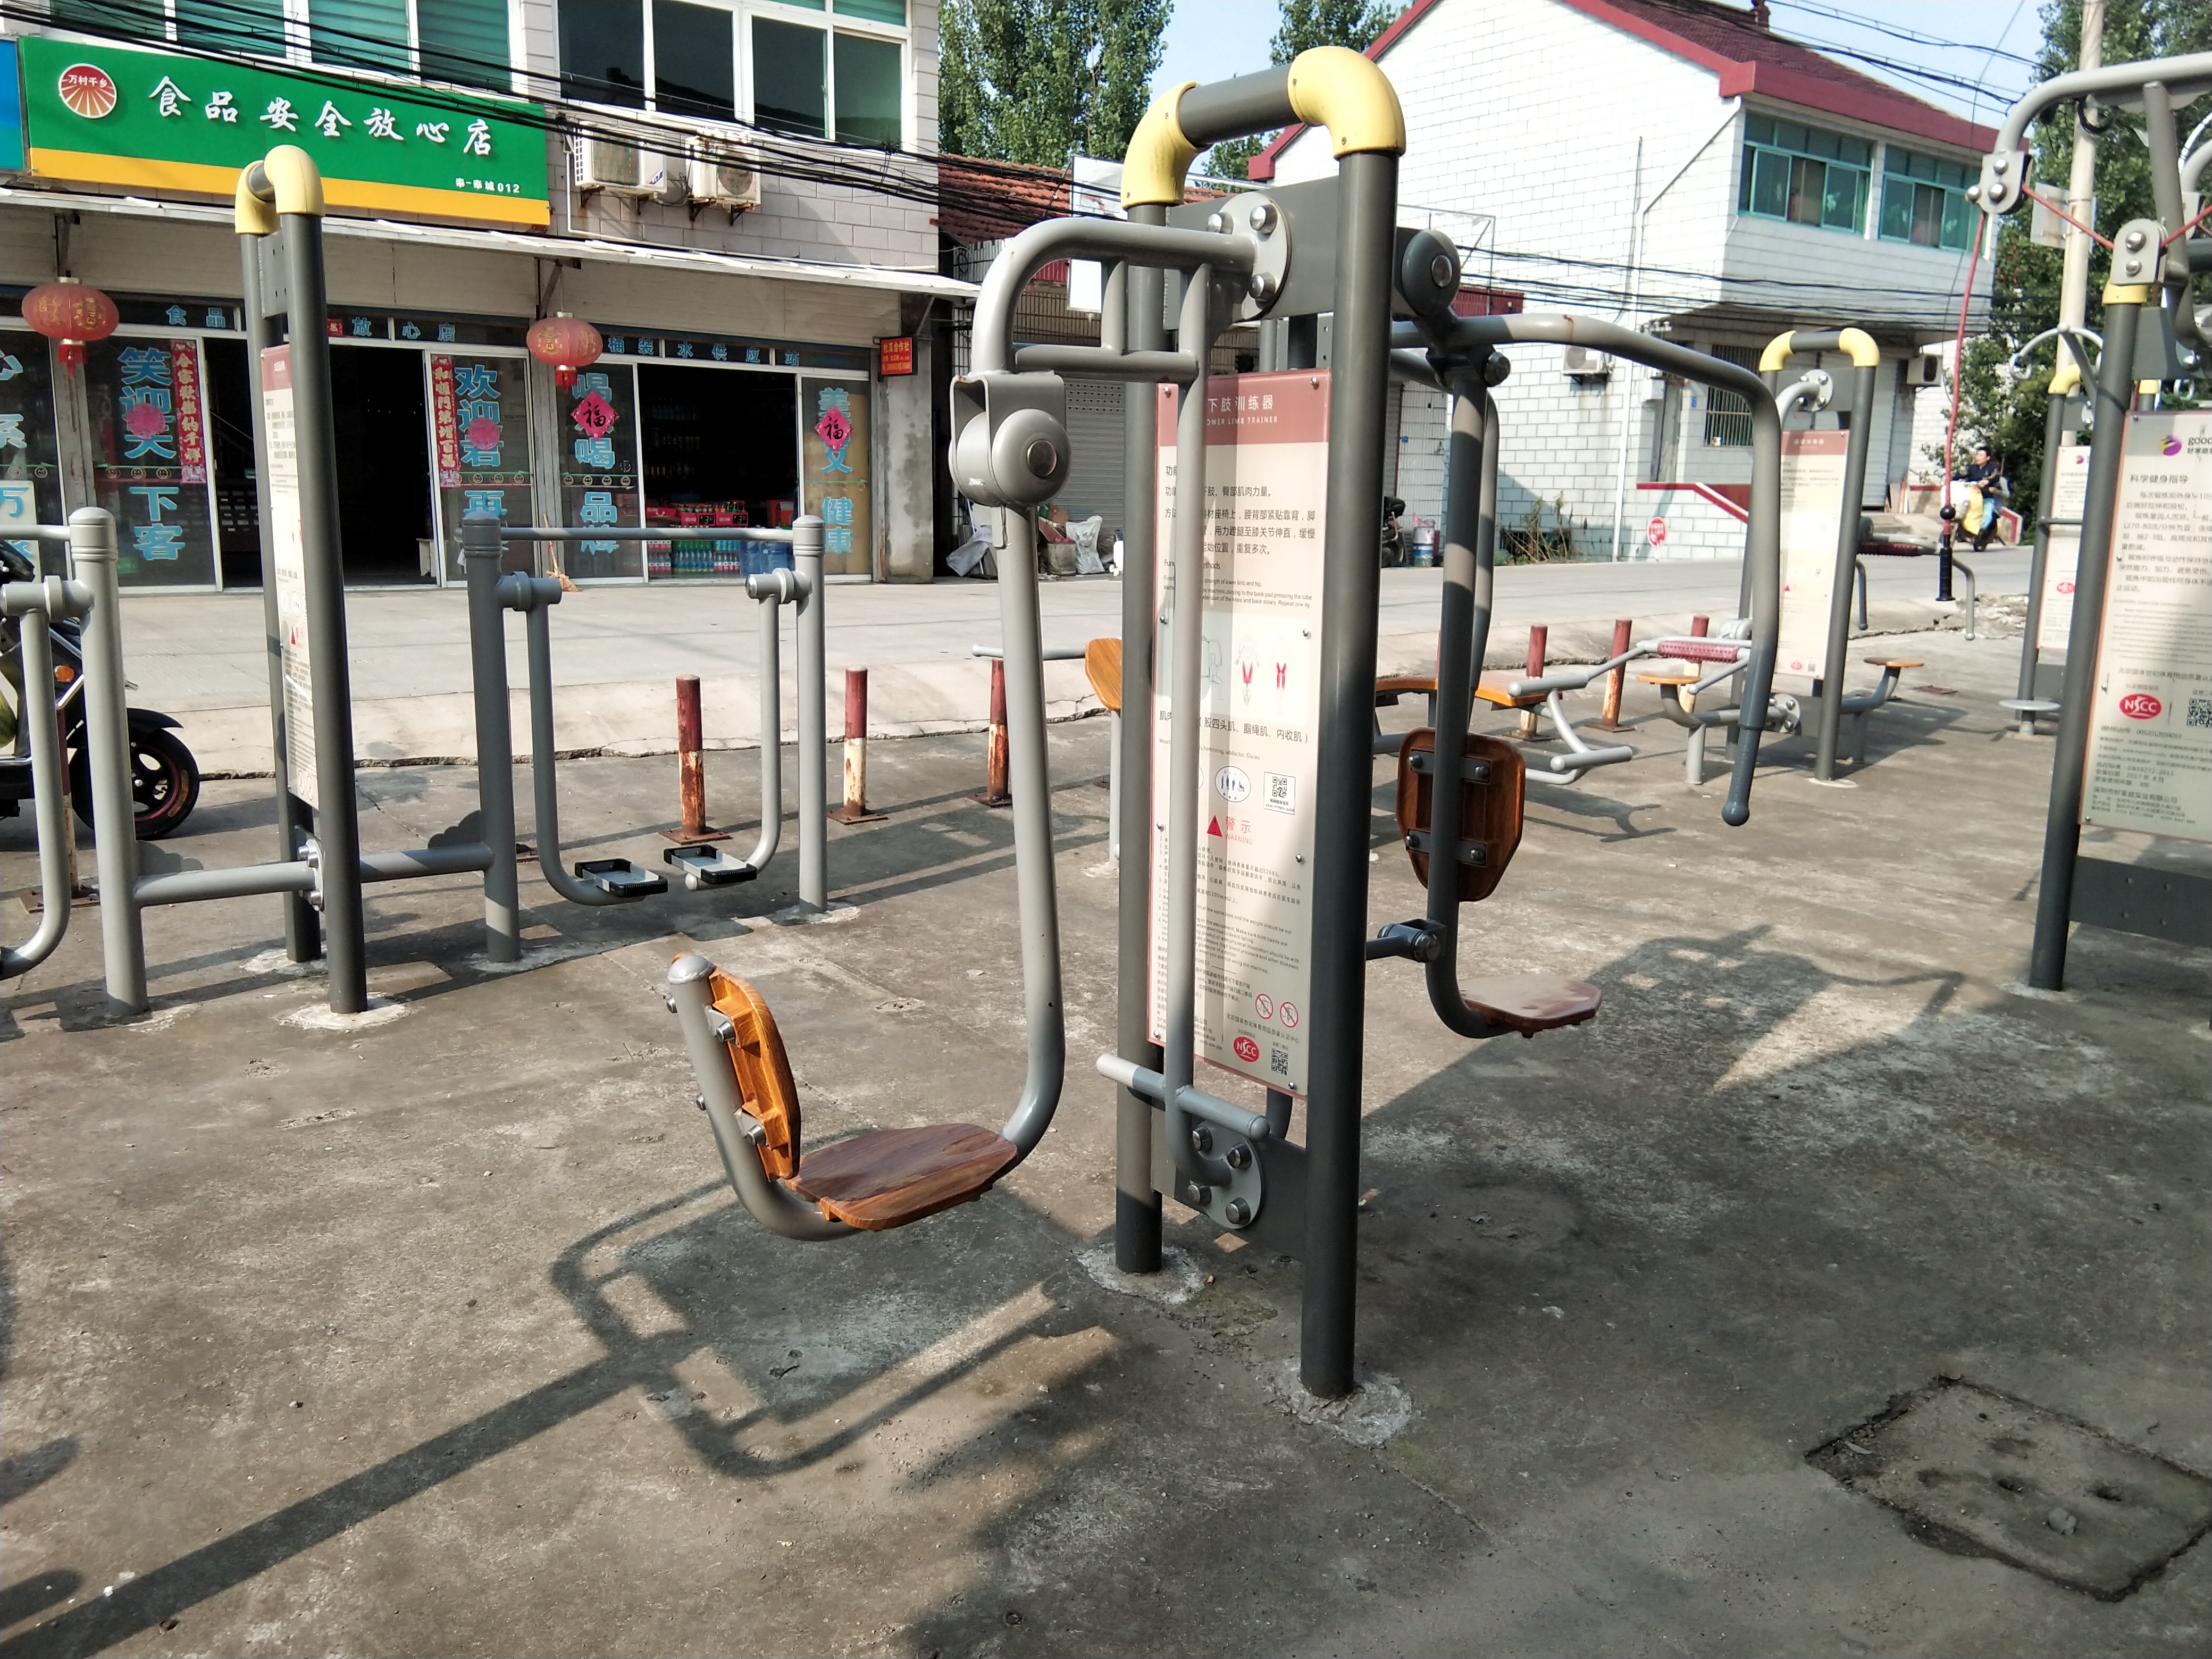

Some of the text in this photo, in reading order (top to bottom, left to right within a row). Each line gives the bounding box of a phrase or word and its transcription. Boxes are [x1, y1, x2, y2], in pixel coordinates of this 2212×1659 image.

[68, 74, 107, 88] 万村千乡
[149, 76, 491, 156] 食品安全放心店
[165, 304, 226, 328] 食品
[352, 317, 456, 342] 放心店
[608, 335, 800, 367] 桶装水供应站
[1208, 395, 1273, 413] 下肢训练器
[583, 401, 606, 428] 福
[1206, 417, 1225, 426] OWER
[824, 415, 844, 440] 福
[118, 346, 186, 561] 笑迎天下客
[2130, 474, 2188, 483] 科学健身指导
[1203, 562, 1220, 570] ethods
[2124, 696, 2157, 714] NSCC
[1226, 816, 1252, 833] 警示
[1225, 832, 1253, 845] WARNING
[1236, 1039, 1257, 1057] NSCC
